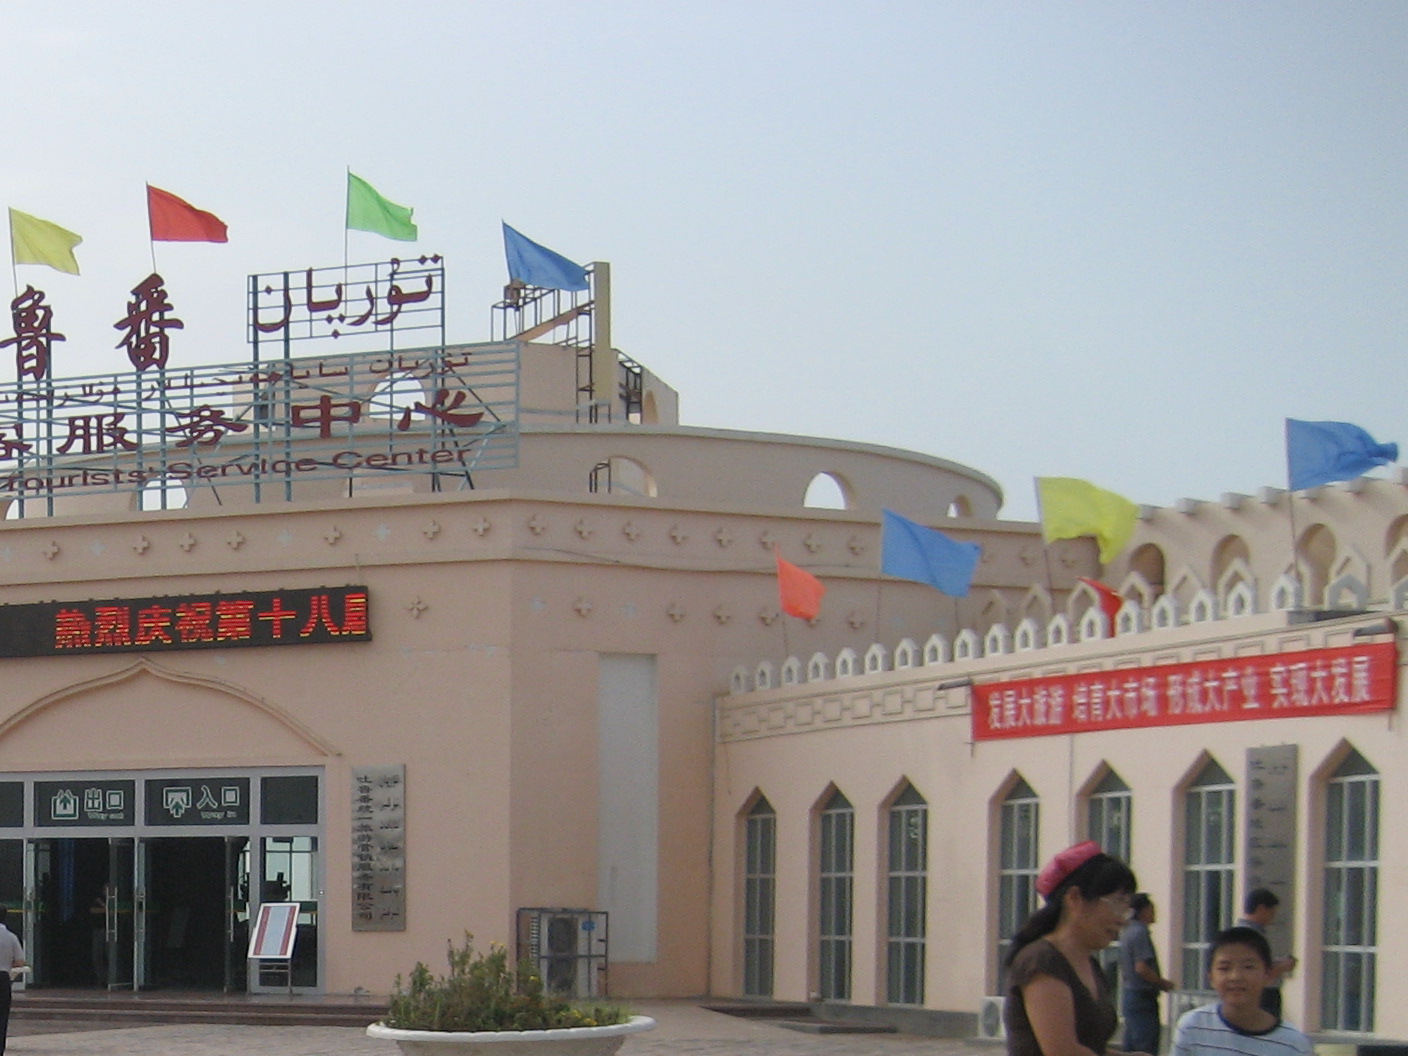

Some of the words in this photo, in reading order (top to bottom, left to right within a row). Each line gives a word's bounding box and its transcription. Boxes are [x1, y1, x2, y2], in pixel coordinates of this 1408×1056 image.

[167, 455, 318, 480] Service
[332, 447, 471, 470] Center
[84, 787, 124, 812] 出口
[196, 784, 240, 810] 入口
